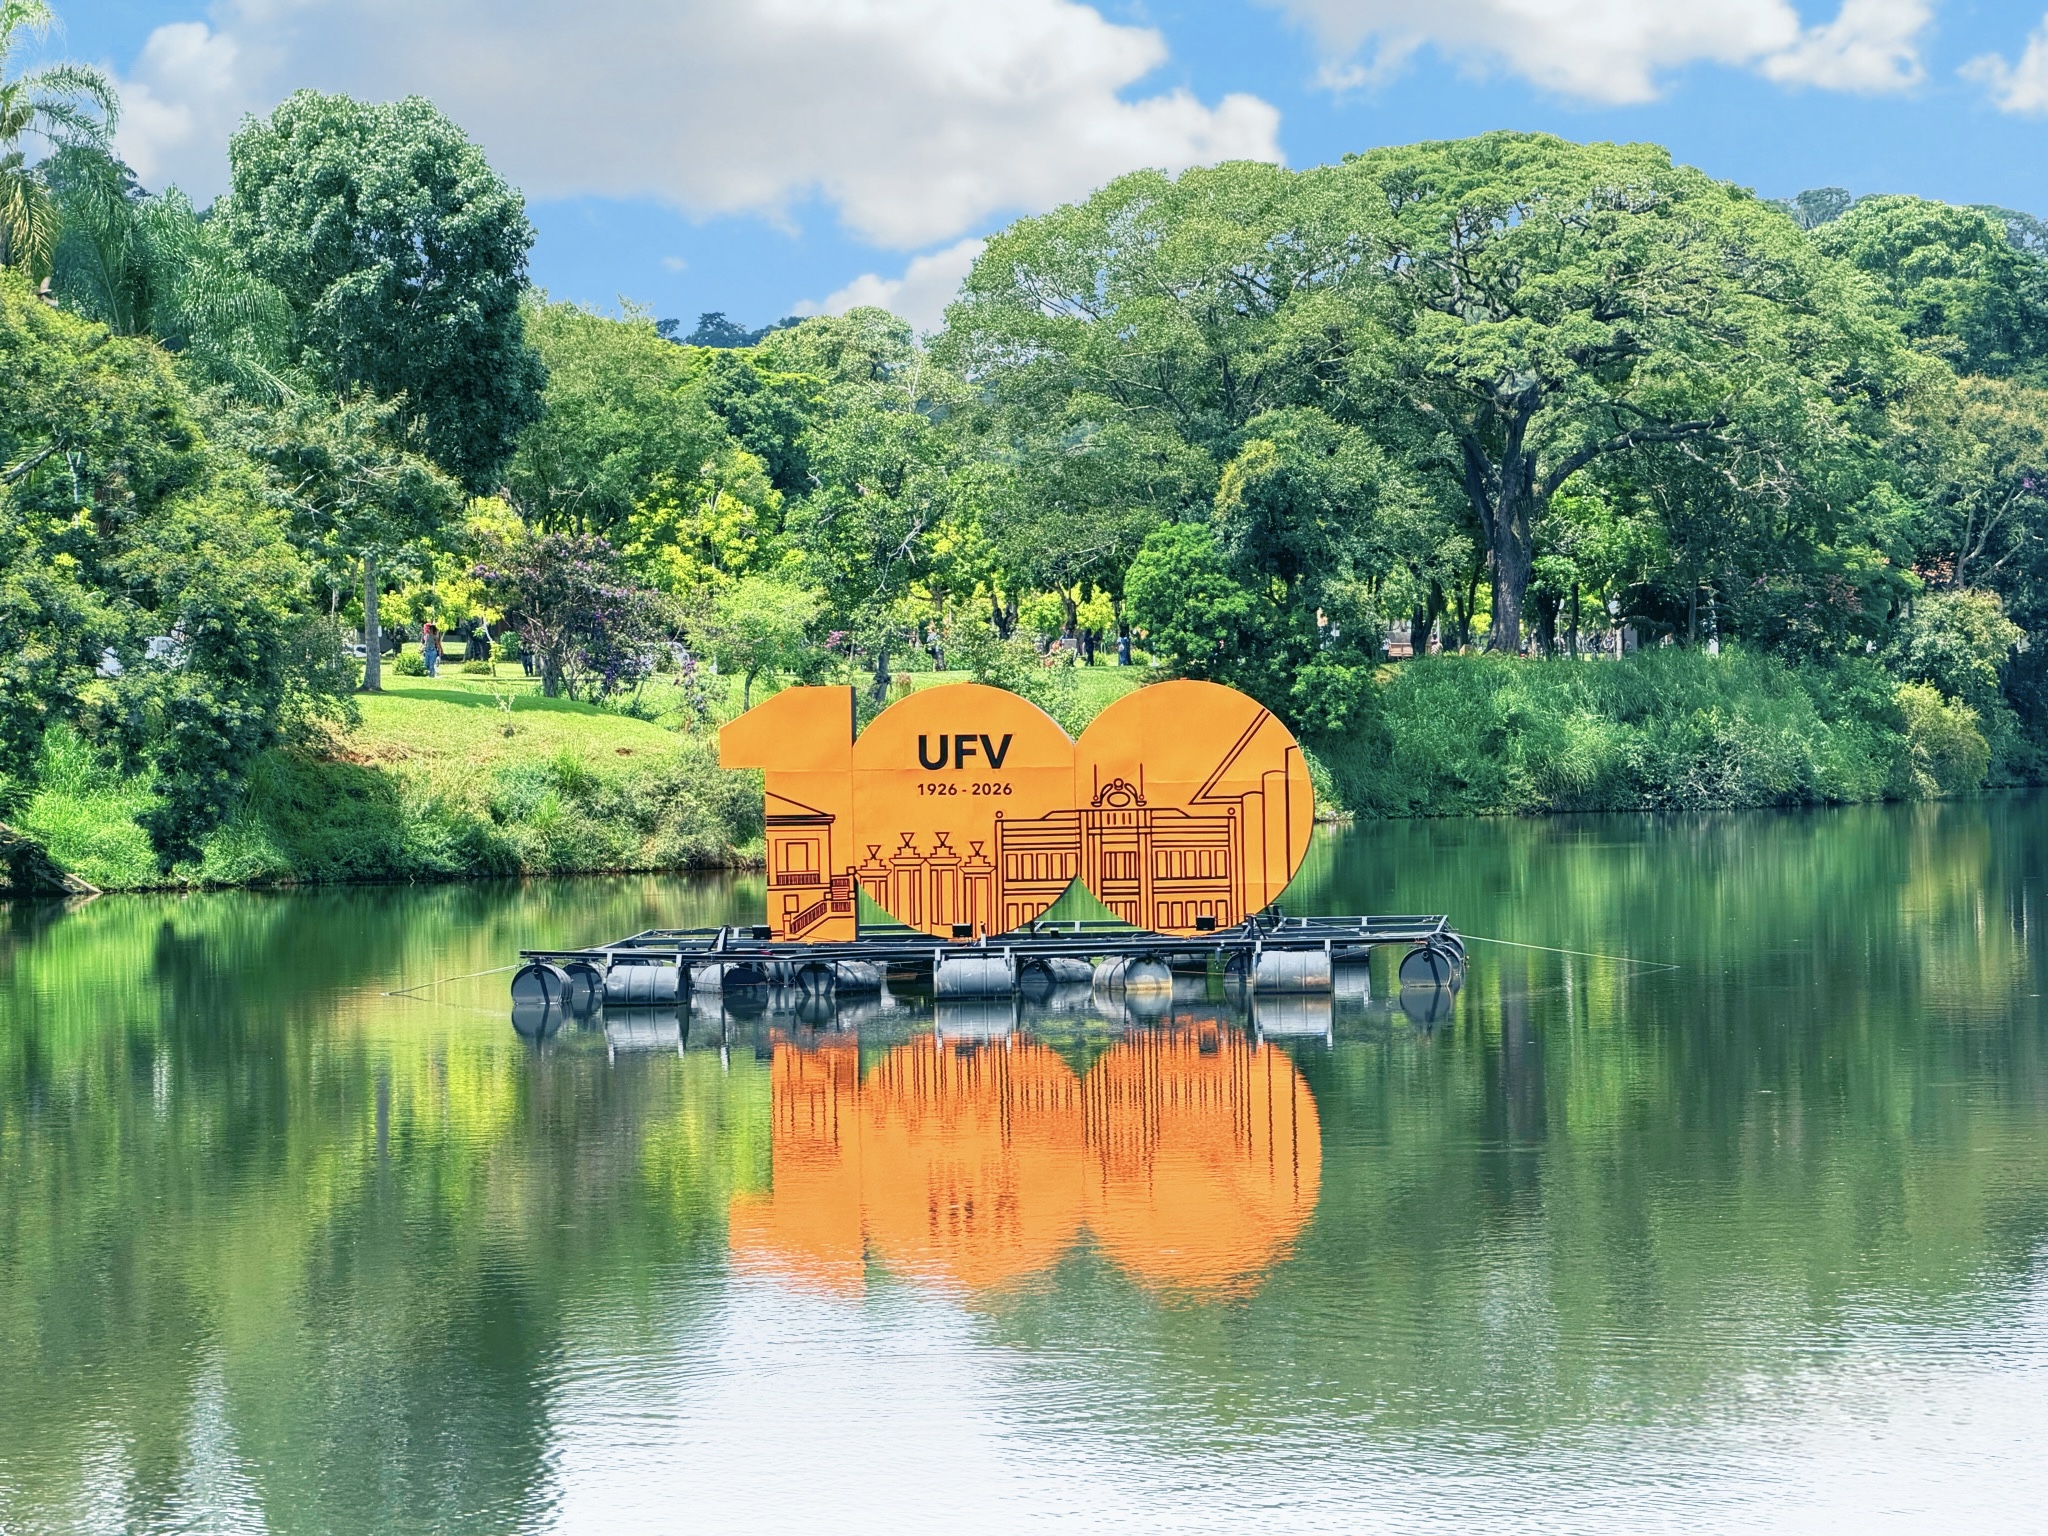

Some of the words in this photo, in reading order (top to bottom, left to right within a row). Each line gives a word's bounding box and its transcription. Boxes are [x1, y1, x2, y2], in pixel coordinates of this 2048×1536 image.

[918, 734, 1013, 770] UFV
[917, 783, 957, 796] 1926
[971, 783, 1013, 796] 2026
[719, 680, 1314, 942] 100
